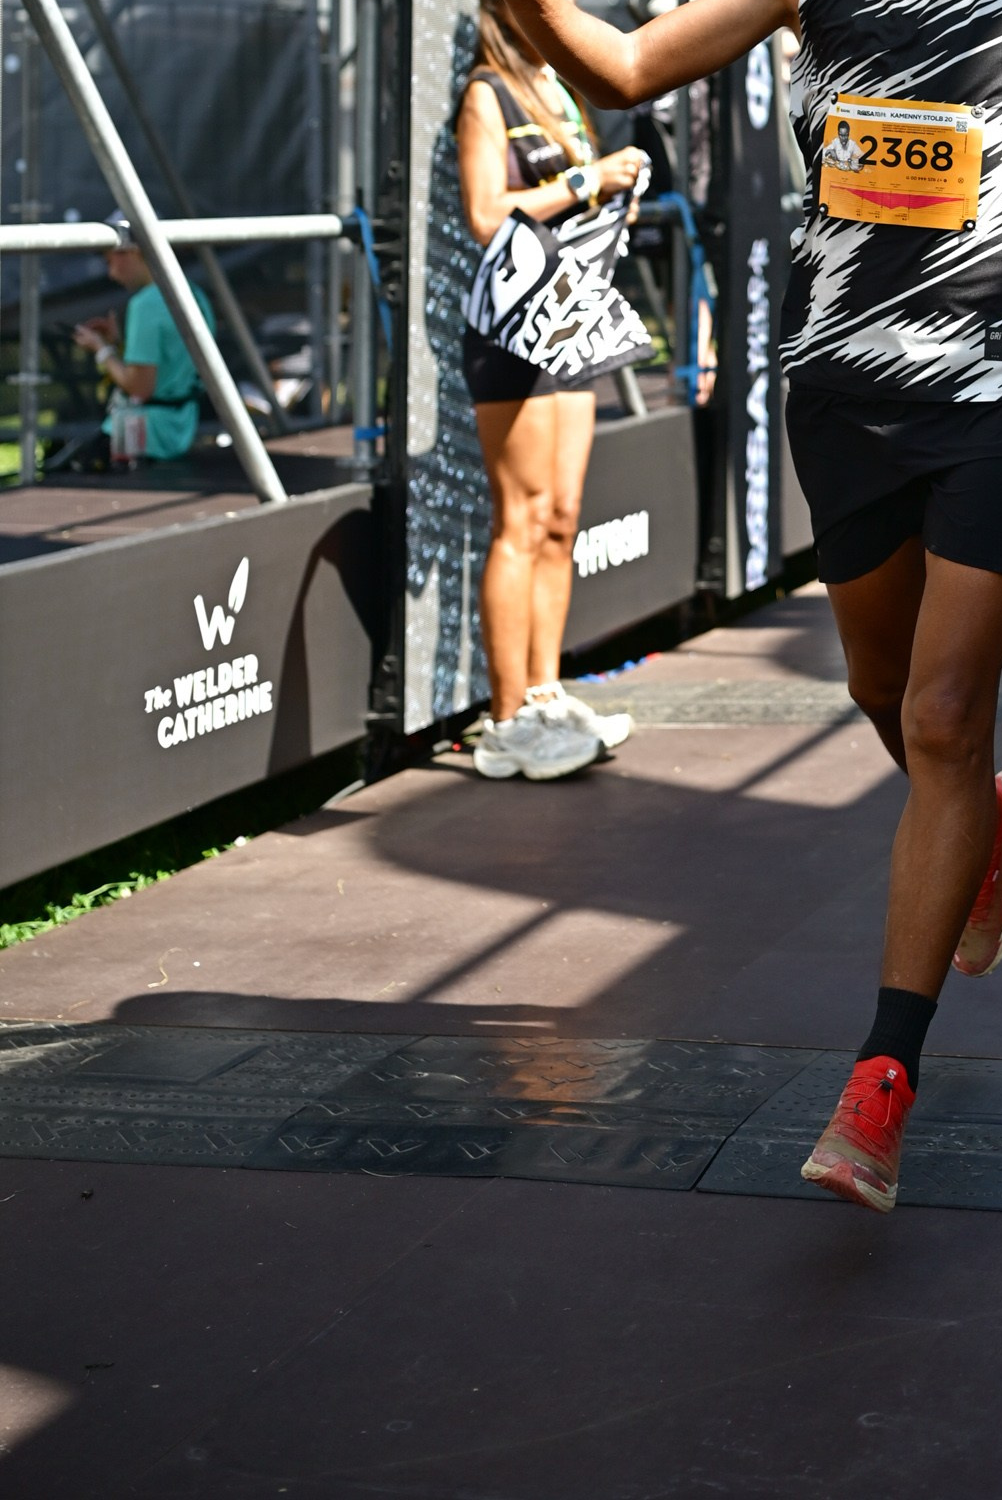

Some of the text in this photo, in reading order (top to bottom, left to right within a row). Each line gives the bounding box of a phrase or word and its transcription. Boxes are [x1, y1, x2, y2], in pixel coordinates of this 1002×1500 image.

[890, 112, 922, 121] KAMENNY
[923, 114, 943, 122] STOLB
[944, 115, 953, 123] 20
[859, 134, 953, 172] 2368
[144, 653, 259, 714] The WELDER
[157, 681, 273, 749] CATHERINE
